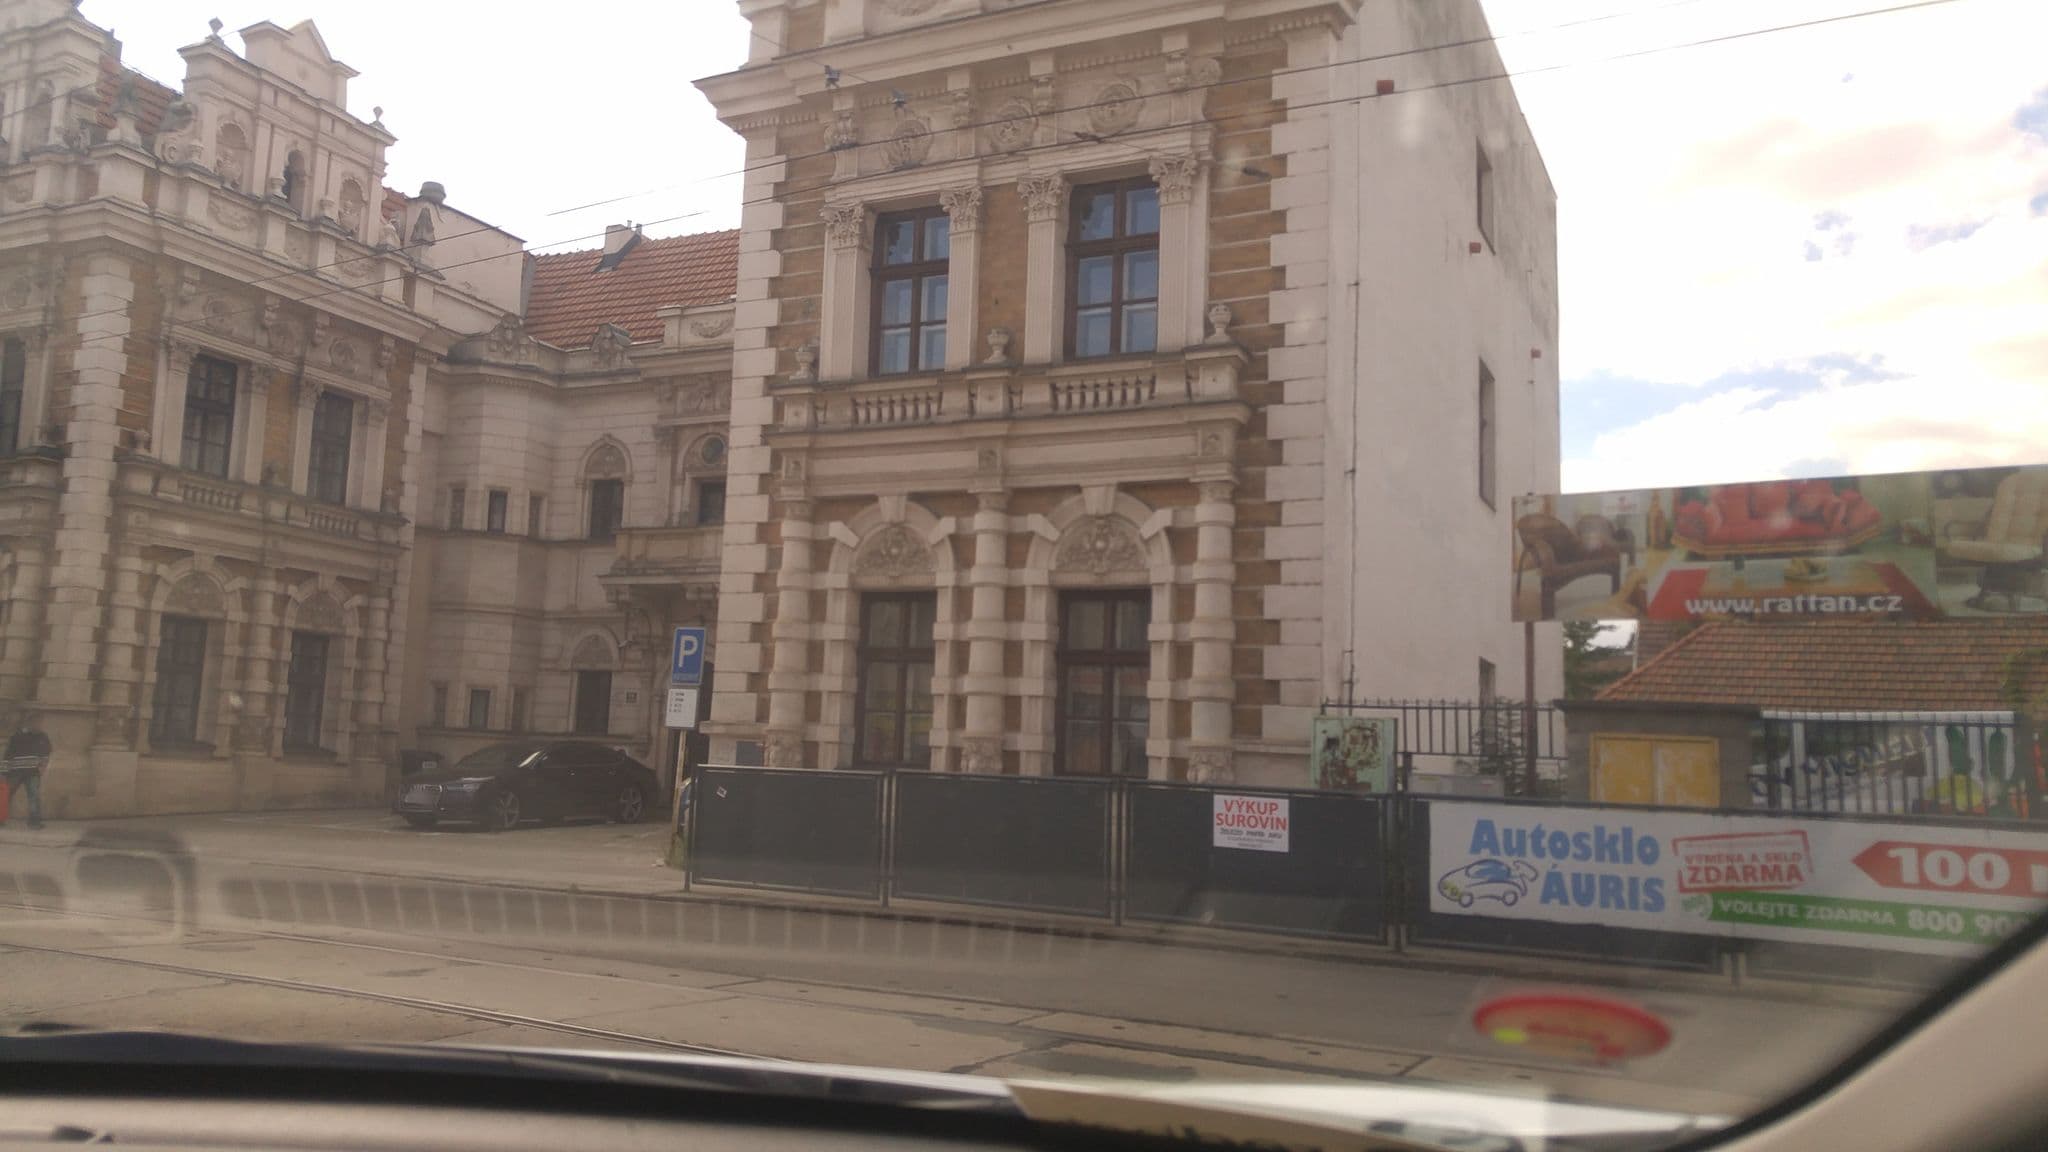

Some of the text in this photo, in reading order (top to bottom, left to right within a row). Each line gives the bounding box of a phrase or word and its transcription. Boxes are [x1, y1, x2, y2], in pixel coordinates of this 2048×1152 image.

[1685, 594, 1903, 614] www.rattan.cz
[678, 635, 698, 668] P
[1216, 813, 1287, 832] SUROVIN
[1224, 798, 1279, 815] VÝKUP
[1470, 819, 1660, 865] Autosklo
[1688, 864, 1805, 883] ZDARMA
[1888, 847, 2010, 889] 100
[1540, 863, 1665, 912] ÁURIS
[1719, 899, 1799, 918] VOLEJTE
[1806, 905, 1896, 926] ZDARMA
[1907, 909, 1965, 934] 800
